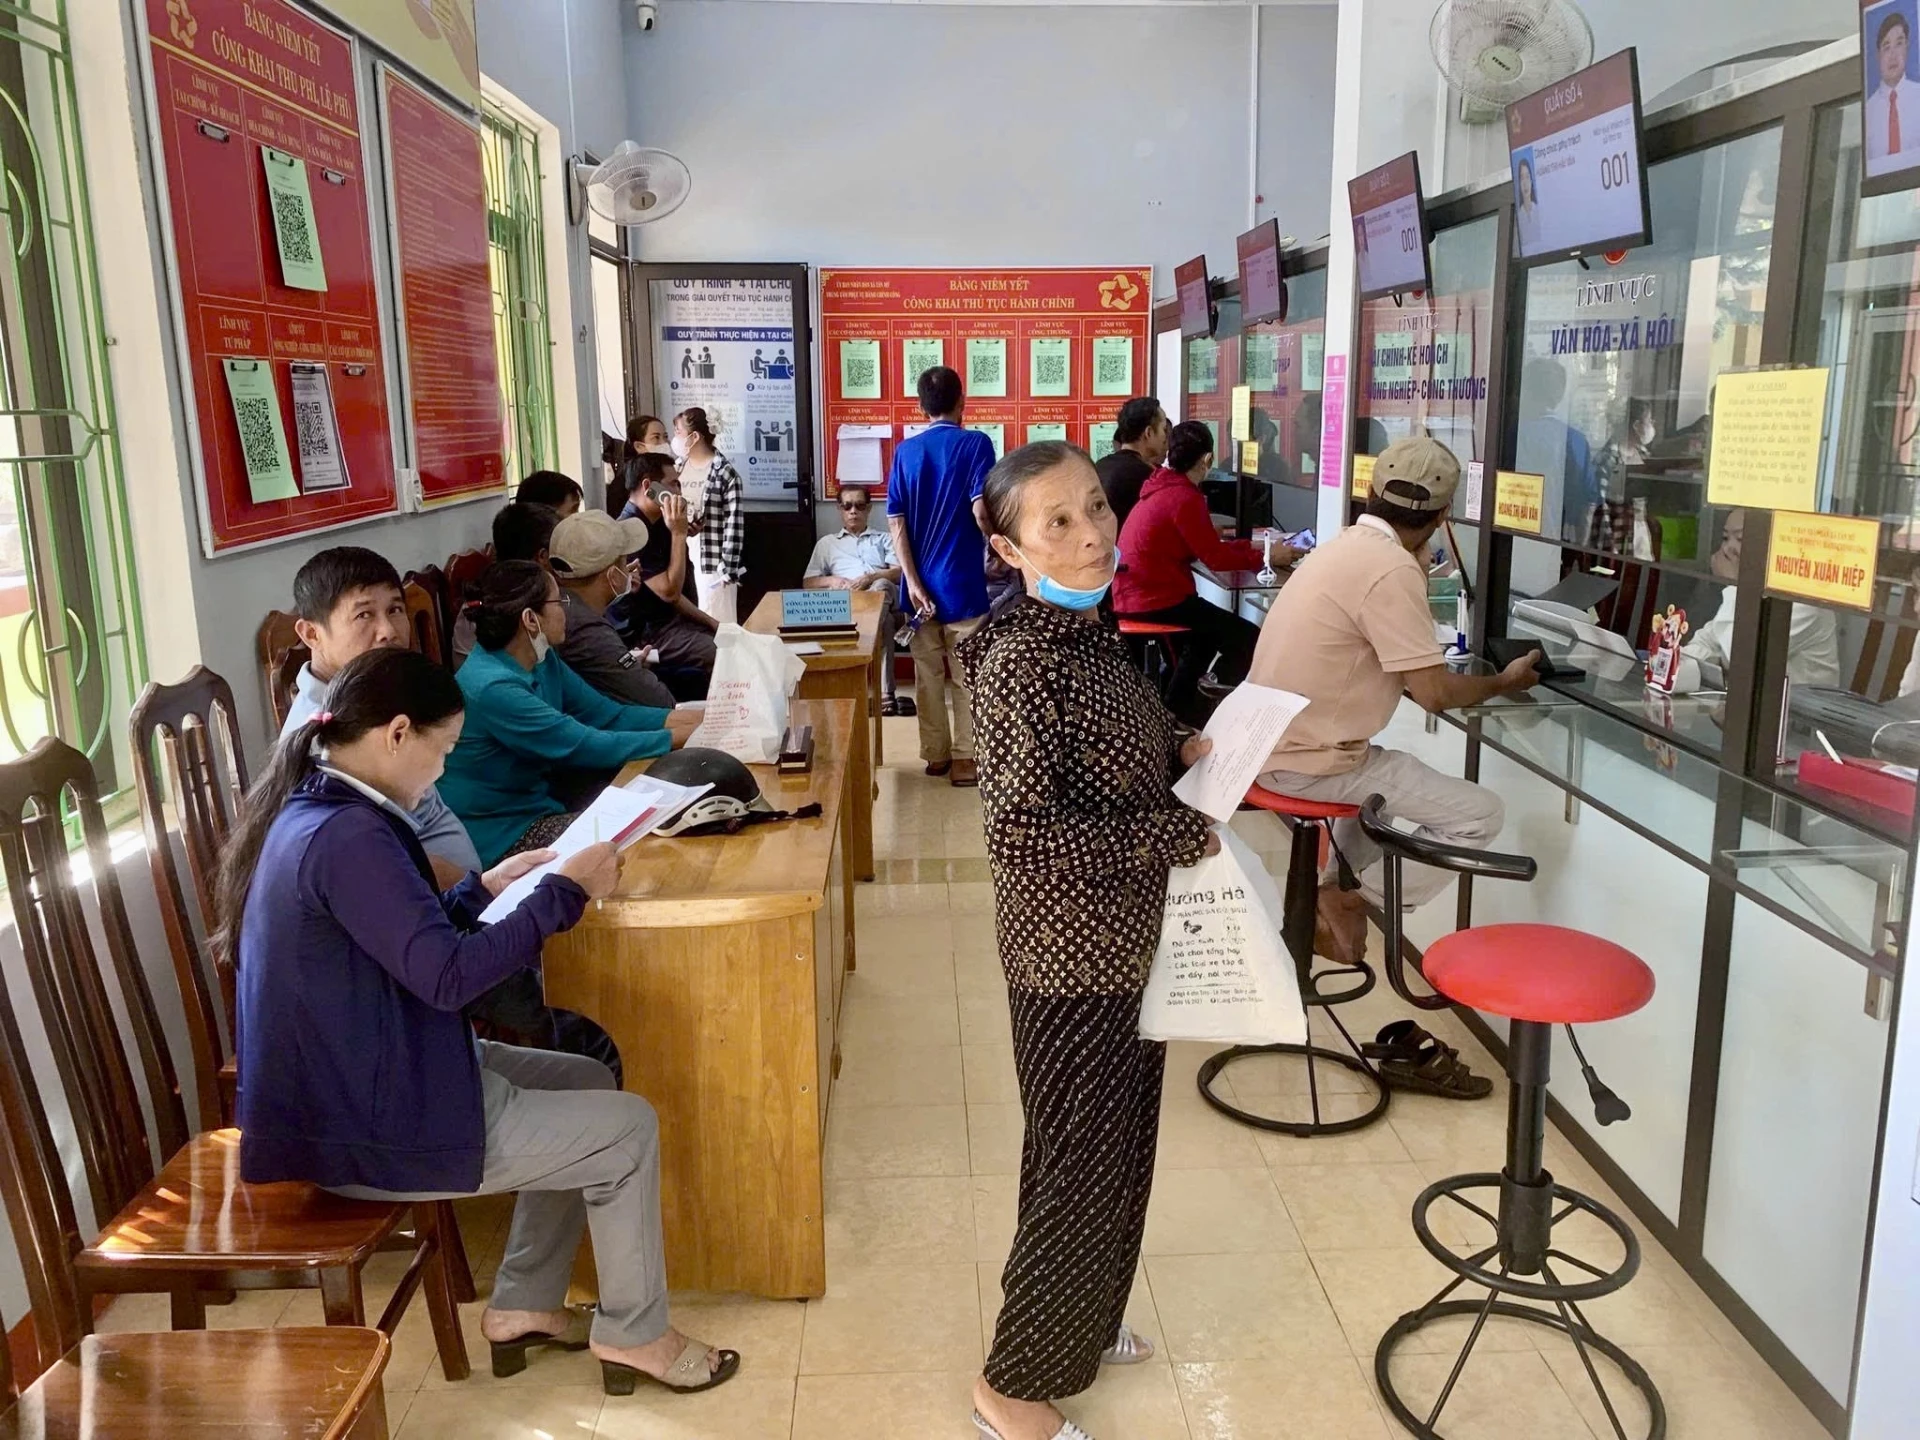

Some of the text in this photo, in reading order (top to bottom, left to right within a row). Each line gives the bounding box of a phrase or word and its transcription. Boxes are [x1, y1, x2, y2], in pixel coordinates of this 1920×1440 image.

[212, 27, 247, 68] CÔNG
[248, 48, 275, 83] KHAI
[302, 32, 320, 66] YẾT
[1565, 81, 1583, 104] SỐ 4
[1601, 151, 1630, 190] 001
[1401, 226, 1418, 252] 001
[950, 275, 1029, 291] BẢNG NIÊM YẾT
[1576, 273, 1655, 308] LĨNH VỰC
[666, 293, 689, 302] TRONG
[708, 291, 730, 302] QUYẾT
[748, 293, 762, 305] TỤC
[903, 294, 1075, 312] CÔNG KHAI THỦ TỤC HÀNH CHÍNH
[1398, 314, 1418, 331] LĨNH
[1552, 323, 1578, 354] VĂN
[1645, 312, 1675, 352] HỘI
[677, 329, 780, 342] QUY TRÌNH THỰC HIỆN 4 TẠI
[1447, 376, 1486, 400] THƯƠNG
[1028, 413, 1070, 422] CHỨNG THỰC
[1775, 548, 1865, 592] NGUYỄN XUÂN HIỆP
